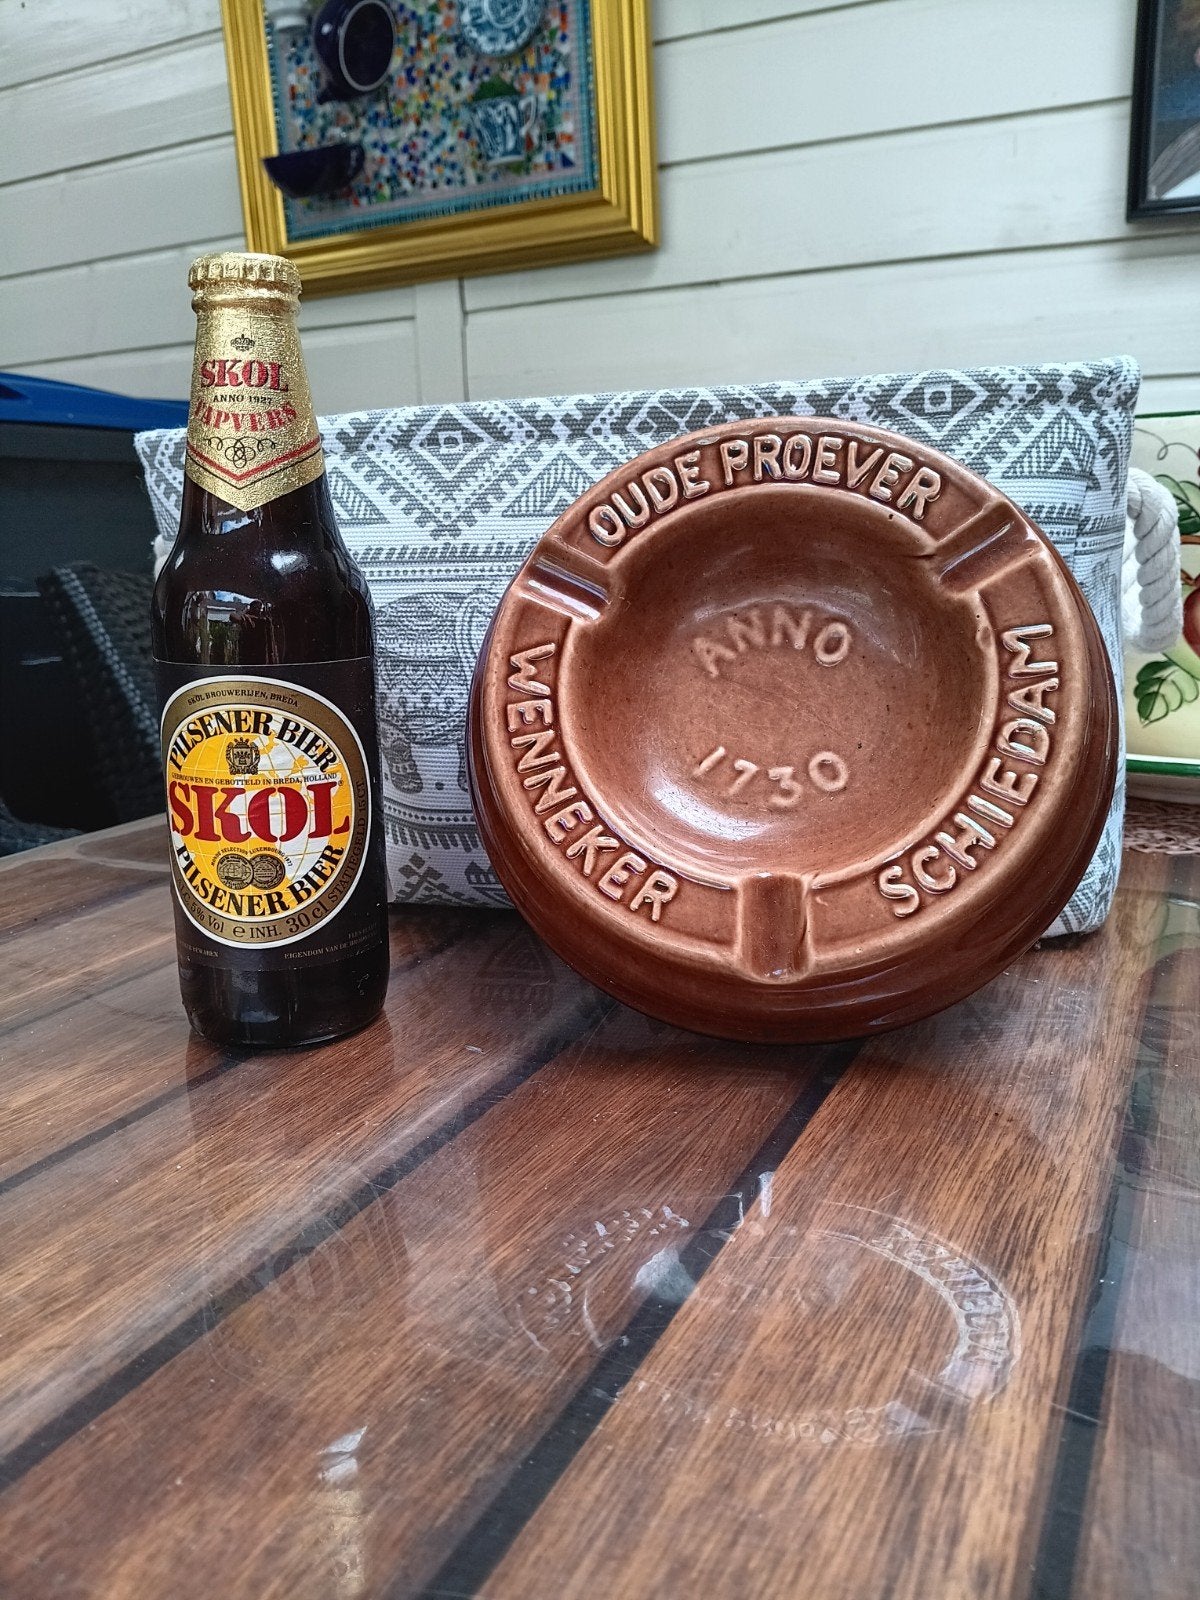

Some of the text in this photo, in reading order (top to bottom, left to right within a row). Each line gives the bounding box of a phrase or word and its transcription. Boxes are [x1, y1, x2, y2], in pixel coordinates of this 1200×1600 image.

[200, 359, 289, 392] SKOL
[213, 394, 273, 405] ANNO 1927
[588, 434, 942, 547] OUDE PROEVER
[693, 606, 852, 678] ANNO
[188, 694, 205, 706] SKOL
[270, 692, 299, 707] BREDA
[169, 710, 339, 773] PILSENER BIER
[879, 624, 1060, 918] SCHIEDAM
[205, 777, 214, 785] EN
[215, 778, 261, 786] GEBOTTELD
[262, 778, 272, 786] IN
[303, 773, 338, 783] HOLLAND
[507, 642, 680, 922] WENNEKER
[691, 746, 850, 808] 1730
[169, 780, 351, 844] SKOL
[177, 845, 290, 917] PILSENER
[287, 844, 345, 906] BIER
[190, 902, 205, 922] 5%
[208, 914, 225, 933] Vol
[249, 925, 282, 939] INH.
[285, 912, 311, 933] 30
[311, 901, 330, 919] cl
[328, 817, 366, 903] STATIEGELD
